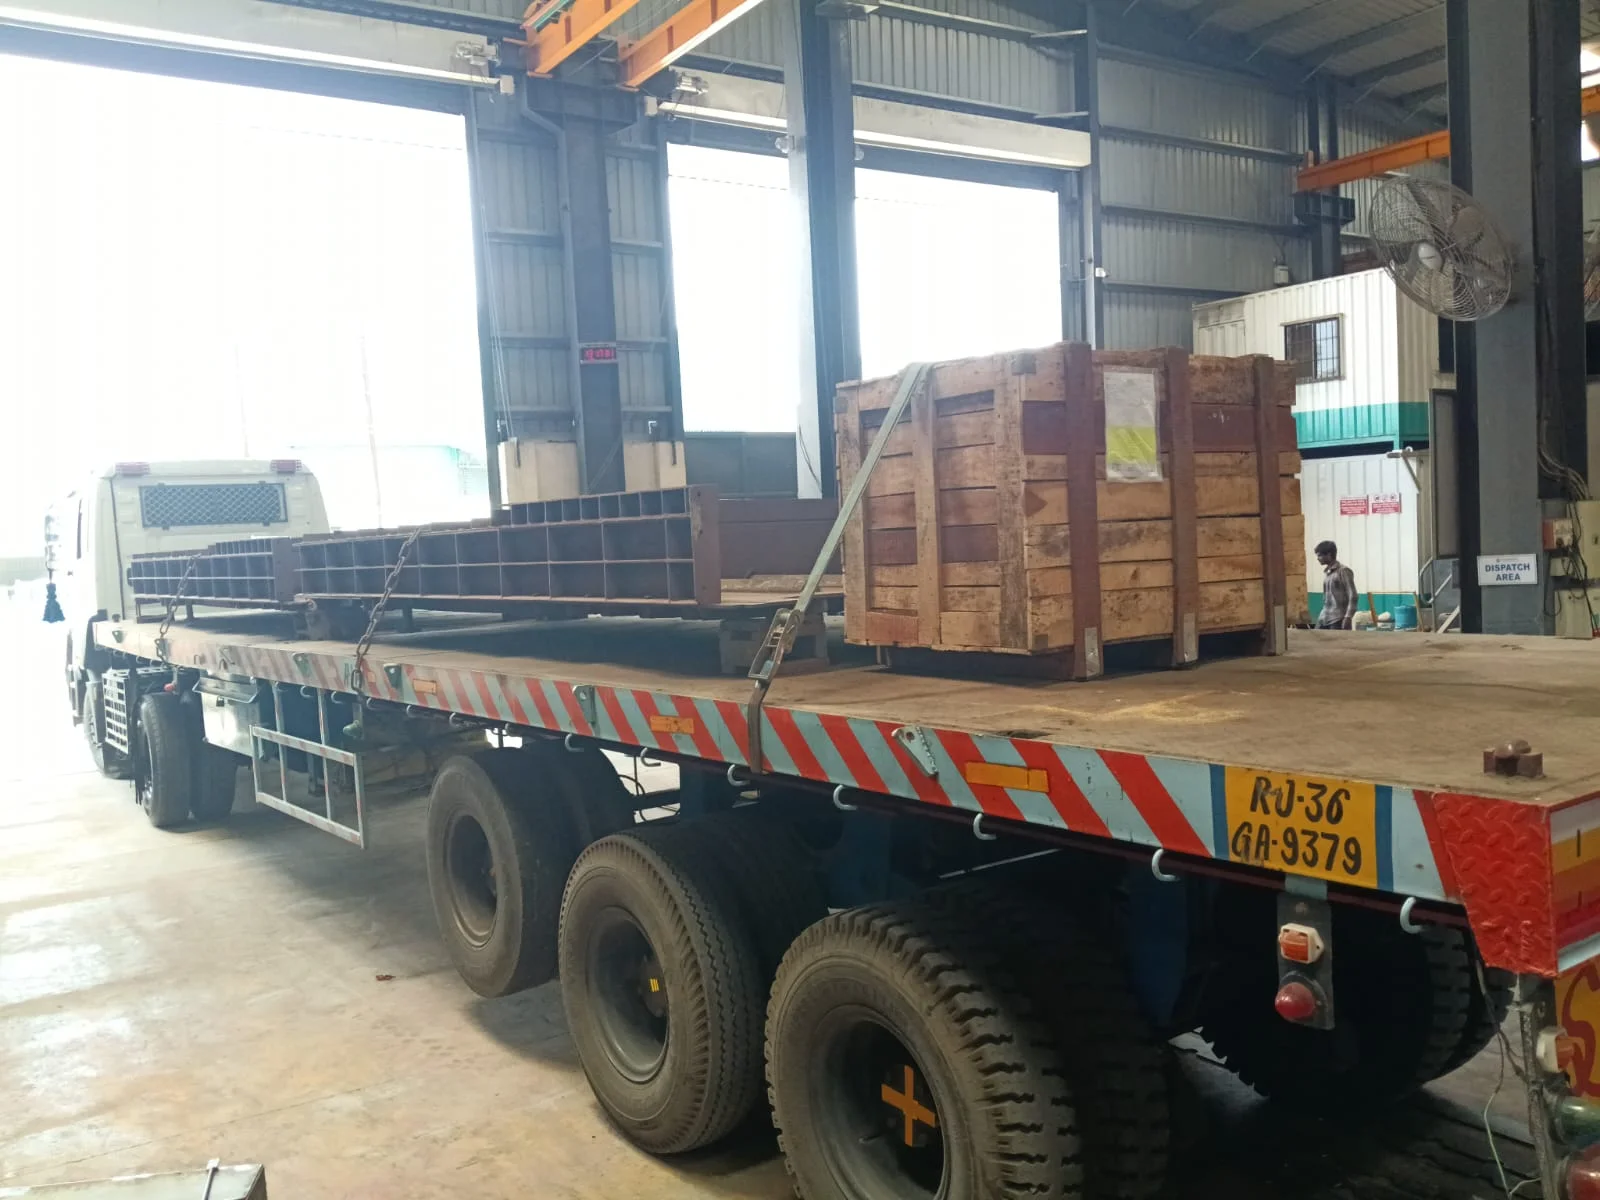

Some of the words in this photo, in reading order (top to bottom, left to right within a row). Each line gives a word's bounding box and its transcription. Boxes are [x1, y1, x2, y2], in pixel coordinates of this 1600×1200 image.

[1485, 563, 1530, 573] DISPATCH
[1496, 573, 1521, 581] AREA
[1231, 821, 1362, 876] GA-9379
